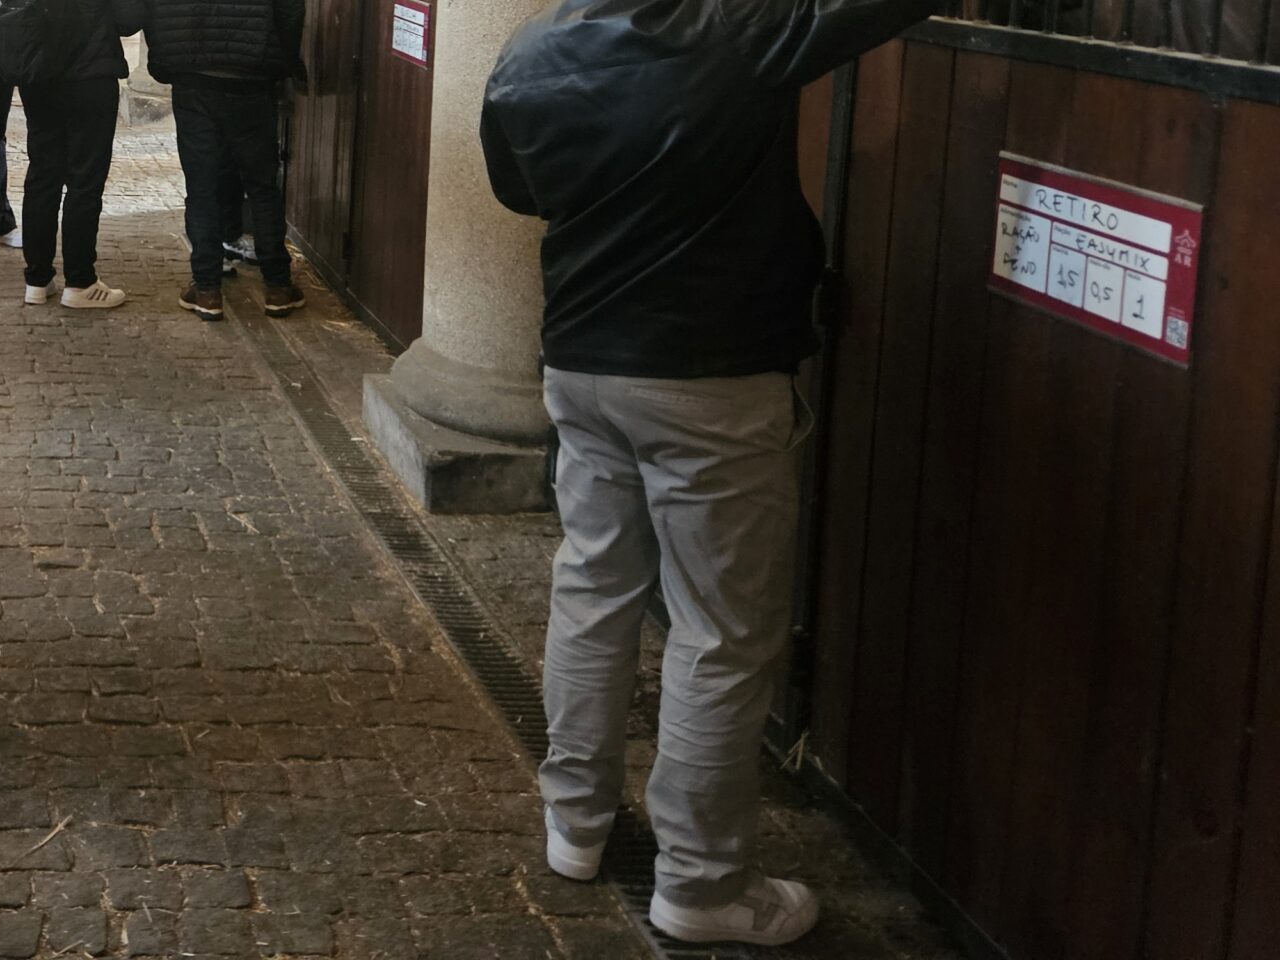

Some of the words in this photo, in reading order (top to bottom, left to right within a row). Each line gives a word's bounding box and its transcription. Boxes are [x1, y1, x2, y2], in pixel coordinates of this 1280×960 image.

[1036, 189, 1118, 230] RETIRO
[1090, 281, 1114, 303] 0,5
[1132, 294, 1145, 320] 1
